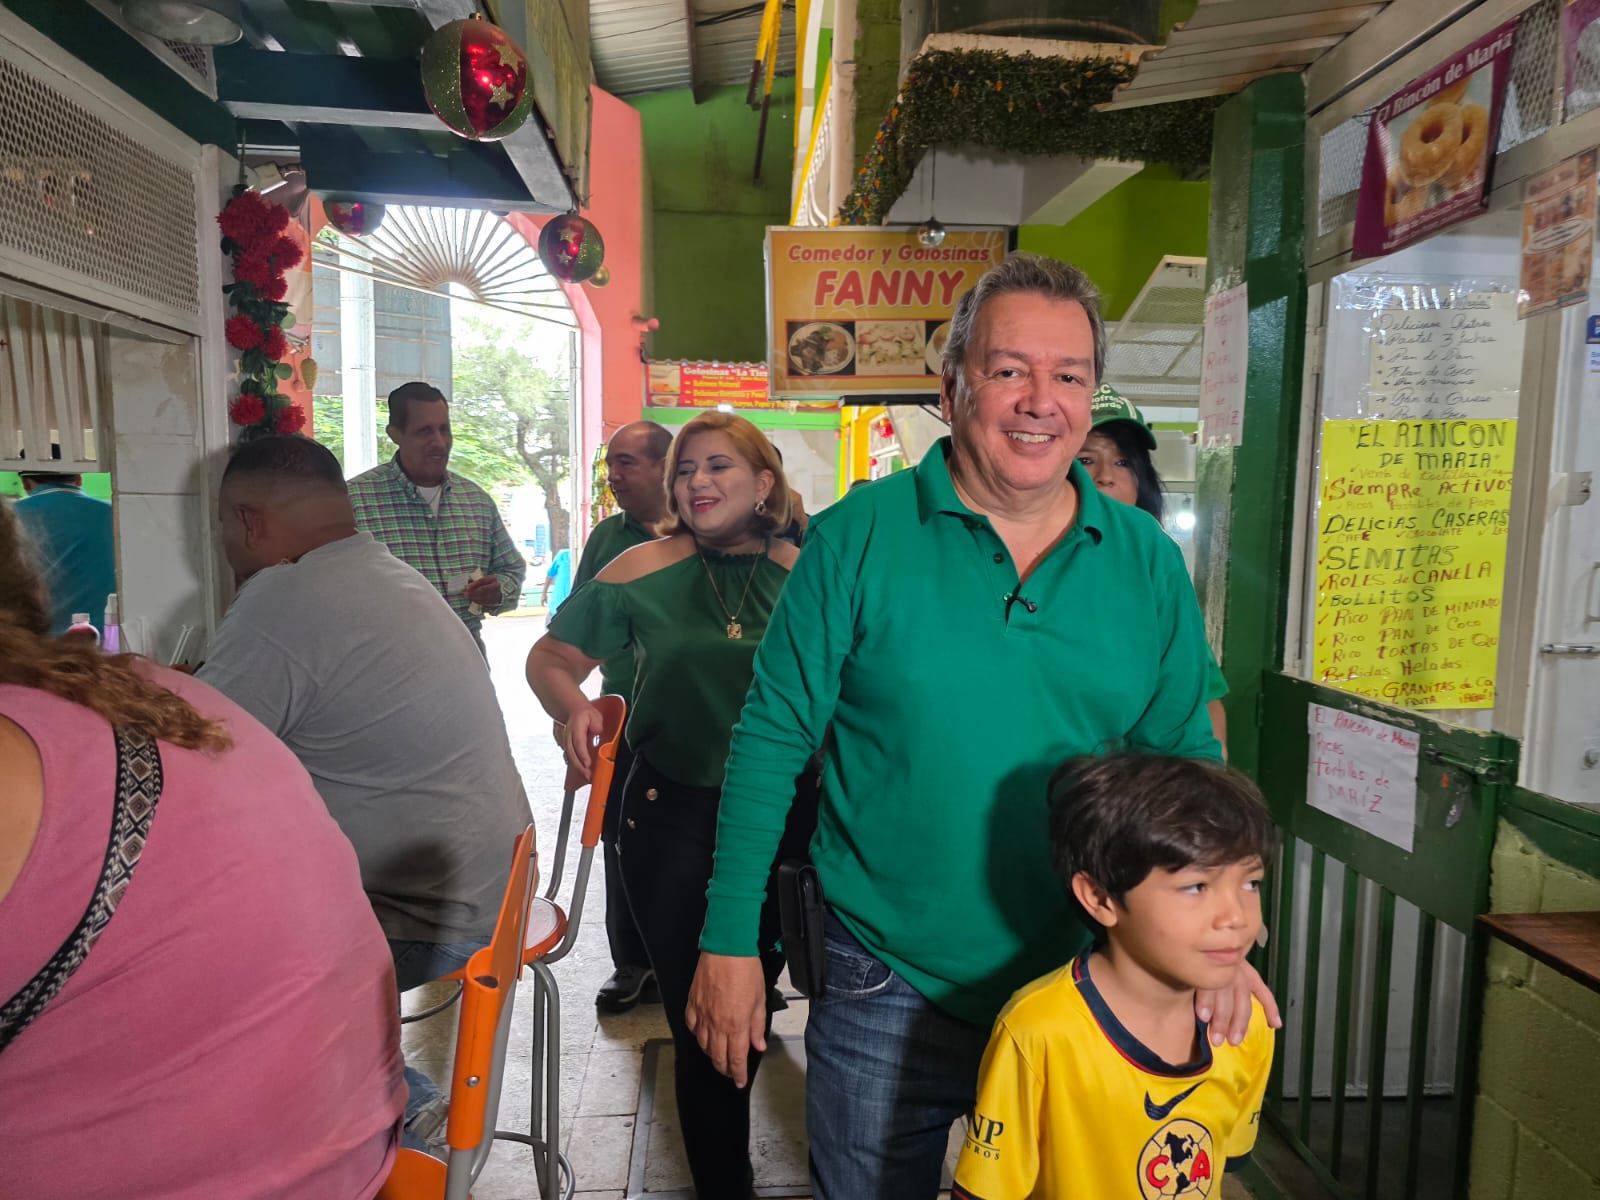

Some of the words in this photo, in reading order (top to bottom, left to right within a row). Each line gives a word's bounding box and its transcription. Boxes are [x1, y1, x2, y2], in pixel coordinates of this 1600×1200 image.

[1445, 63, 1464, 85] de
[788, 245, 875, 261] Comedor
[881, 247, 892, 264] y
[899, 244, 990, 261] Golosinas
[814, 269, 966, 307] FANNY
[1356, 424, 1385, 449] EL
[1395, 421, 1507, 449] RINCON
[1379, 453, 1405, 468] DE
[1416, 452, 1492, 470] MARIA
[1432, 508, 1510, 528] CASERAS
[1326, 545, 1459, 571] SEMITAS
[1328, 573, 1386, 590] ROLES
[1412, 562, 1492, 585] CANELA
[1379, 606, 1415, 625] PAN
[1423, 606, 1440, 618] DE
[1332, 631, 1365, 648] Rico
[1379, 628, 1415, 643] PAN
[1446, 616, 1481, 631] Coco
[1448, 637, 1465, 649] DE
